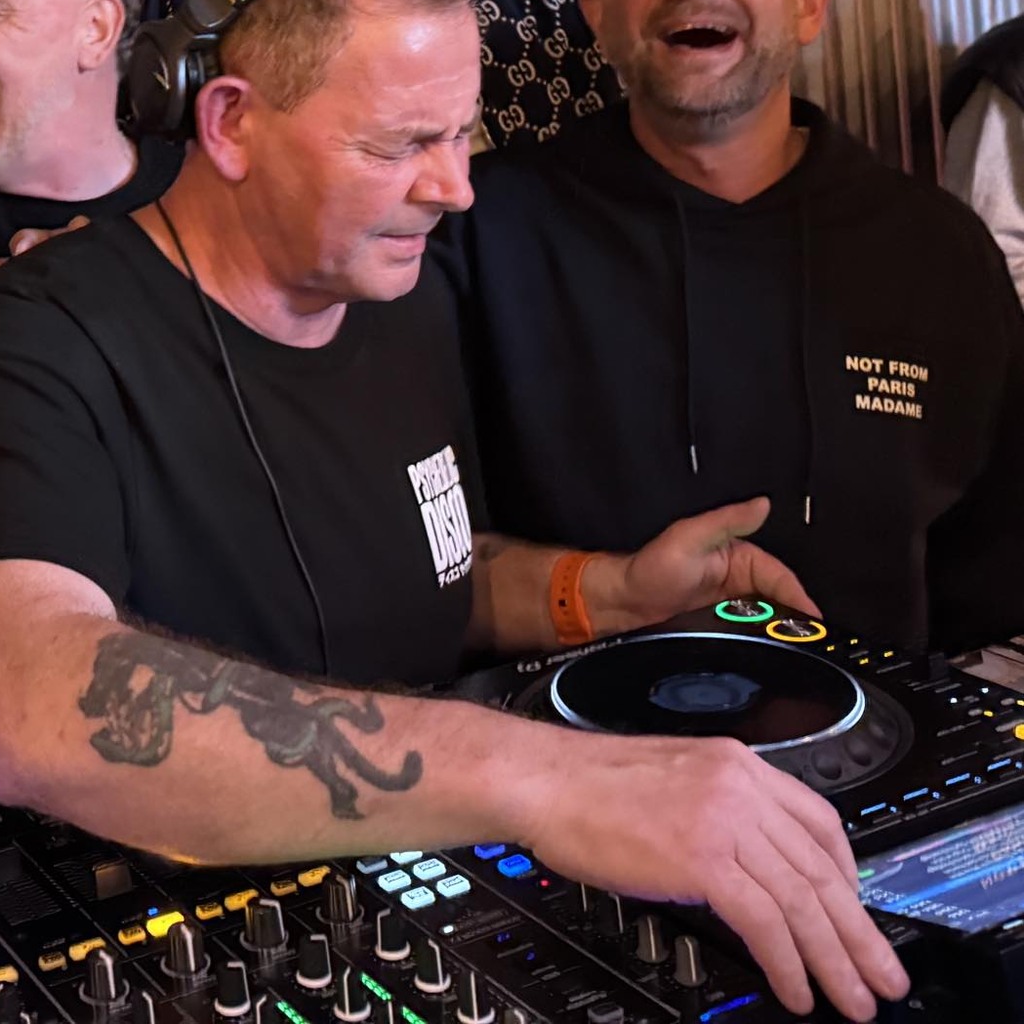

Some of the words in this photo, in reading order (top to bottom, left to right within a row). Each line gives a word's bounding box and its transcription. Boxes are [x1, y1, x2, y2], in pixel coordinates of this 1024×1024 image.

[845, 355, 883, 373] NOT
[889, 360, 928, 382] FROM
[867, 376, 915, 398] PARIS
[855, 394, 923, 419] MADAME
